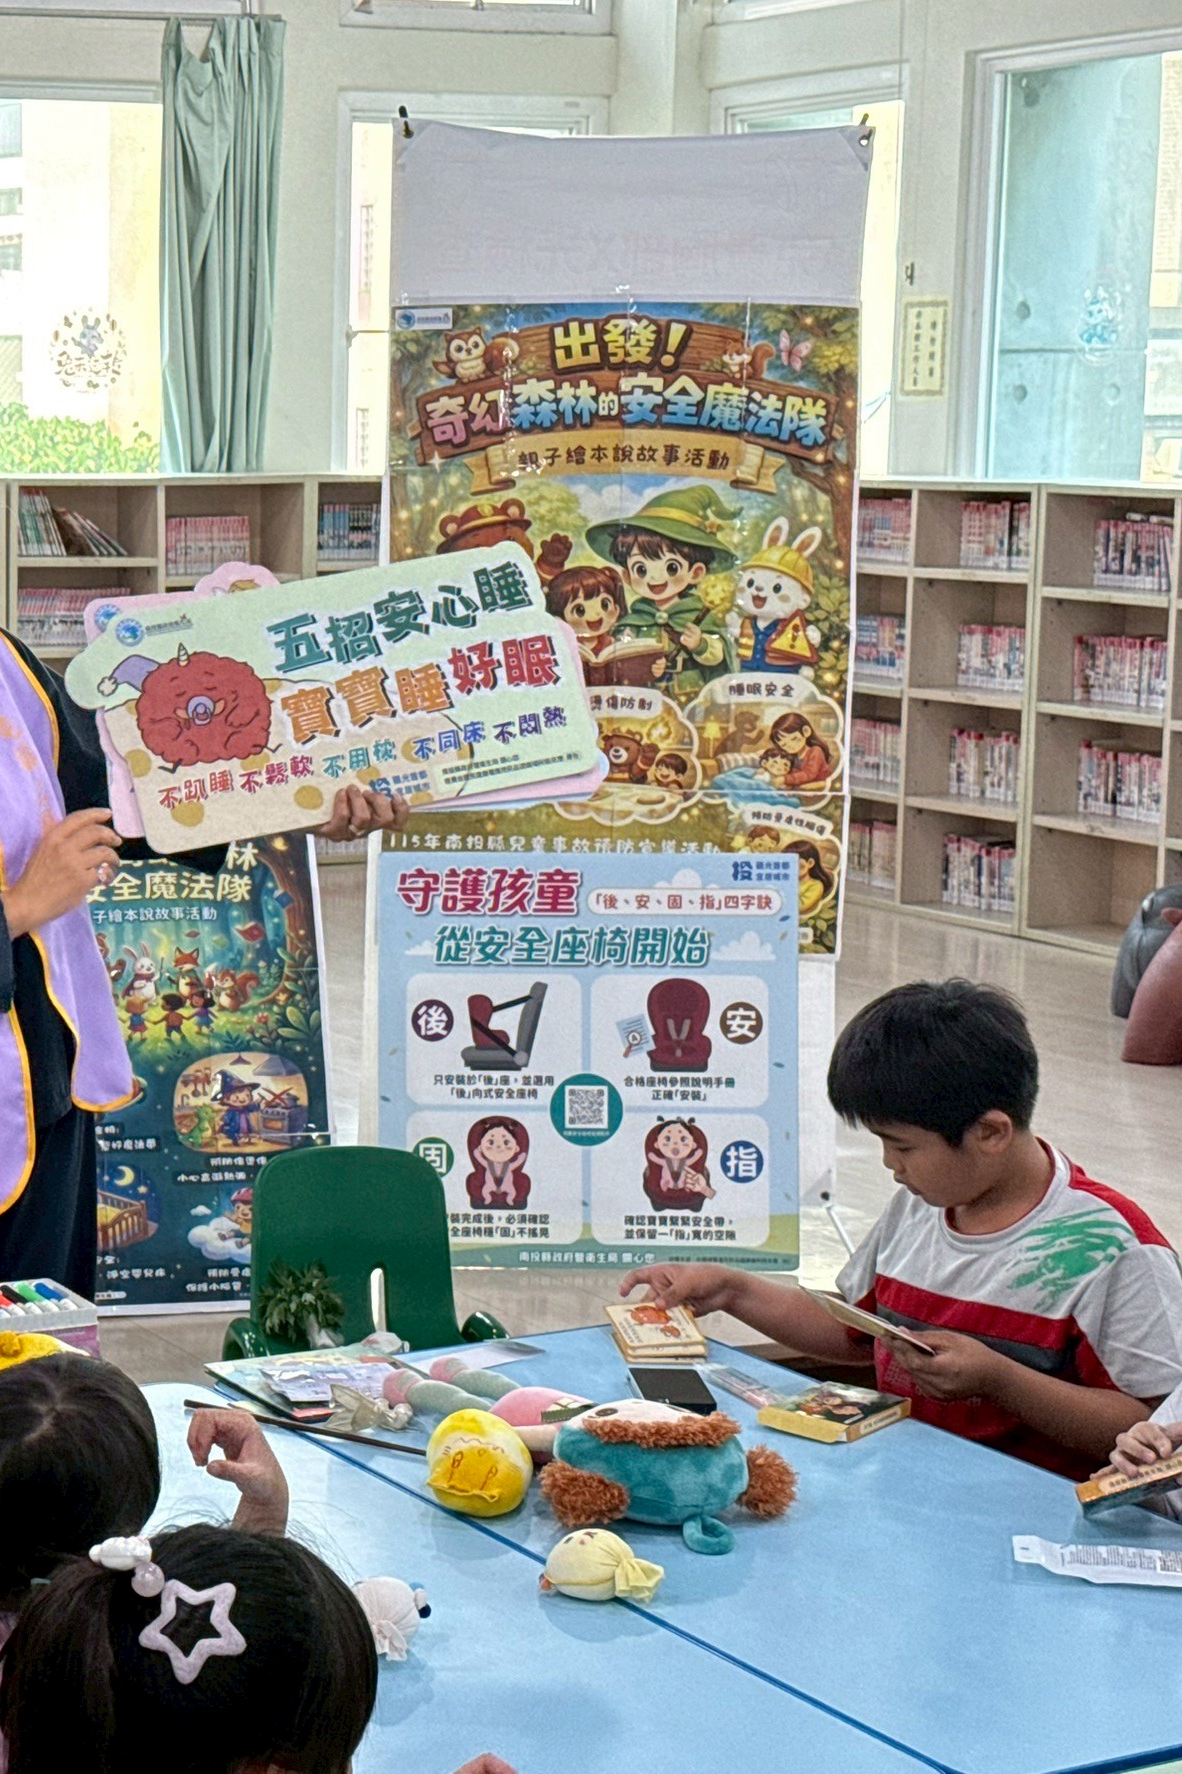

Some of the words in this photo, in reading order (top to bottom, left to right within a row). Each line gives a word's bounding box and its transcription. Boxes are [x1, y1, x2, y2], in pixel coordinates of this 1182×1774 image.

[424, 372, 830, 448] 奇幻森林的安全魔法隊
[517, 443, 731, 470] 親子繪本說故事活動
[267, 560, 534, 674] 五招安心睡
[280, 634, 562, 746] 寶寶睡好眠
[158, 769, 234, 810] 不趴睡
[322, 738, 397, 779] 不用枕
[412, 720, 486, 761] 不同床
[492, 705, 567, 744] 不悶熱
[397, 867, 581, 916] 守護孩童
[435, 925, 711, 966] 從安全座椅開始
[418, 1005, 450, 1036] 後
[726, 1007, 758, 1039] 安
[726, 1146, 757, 1178] 指
[447, 1213, 550, 1225] 裝完成後，必須確認
